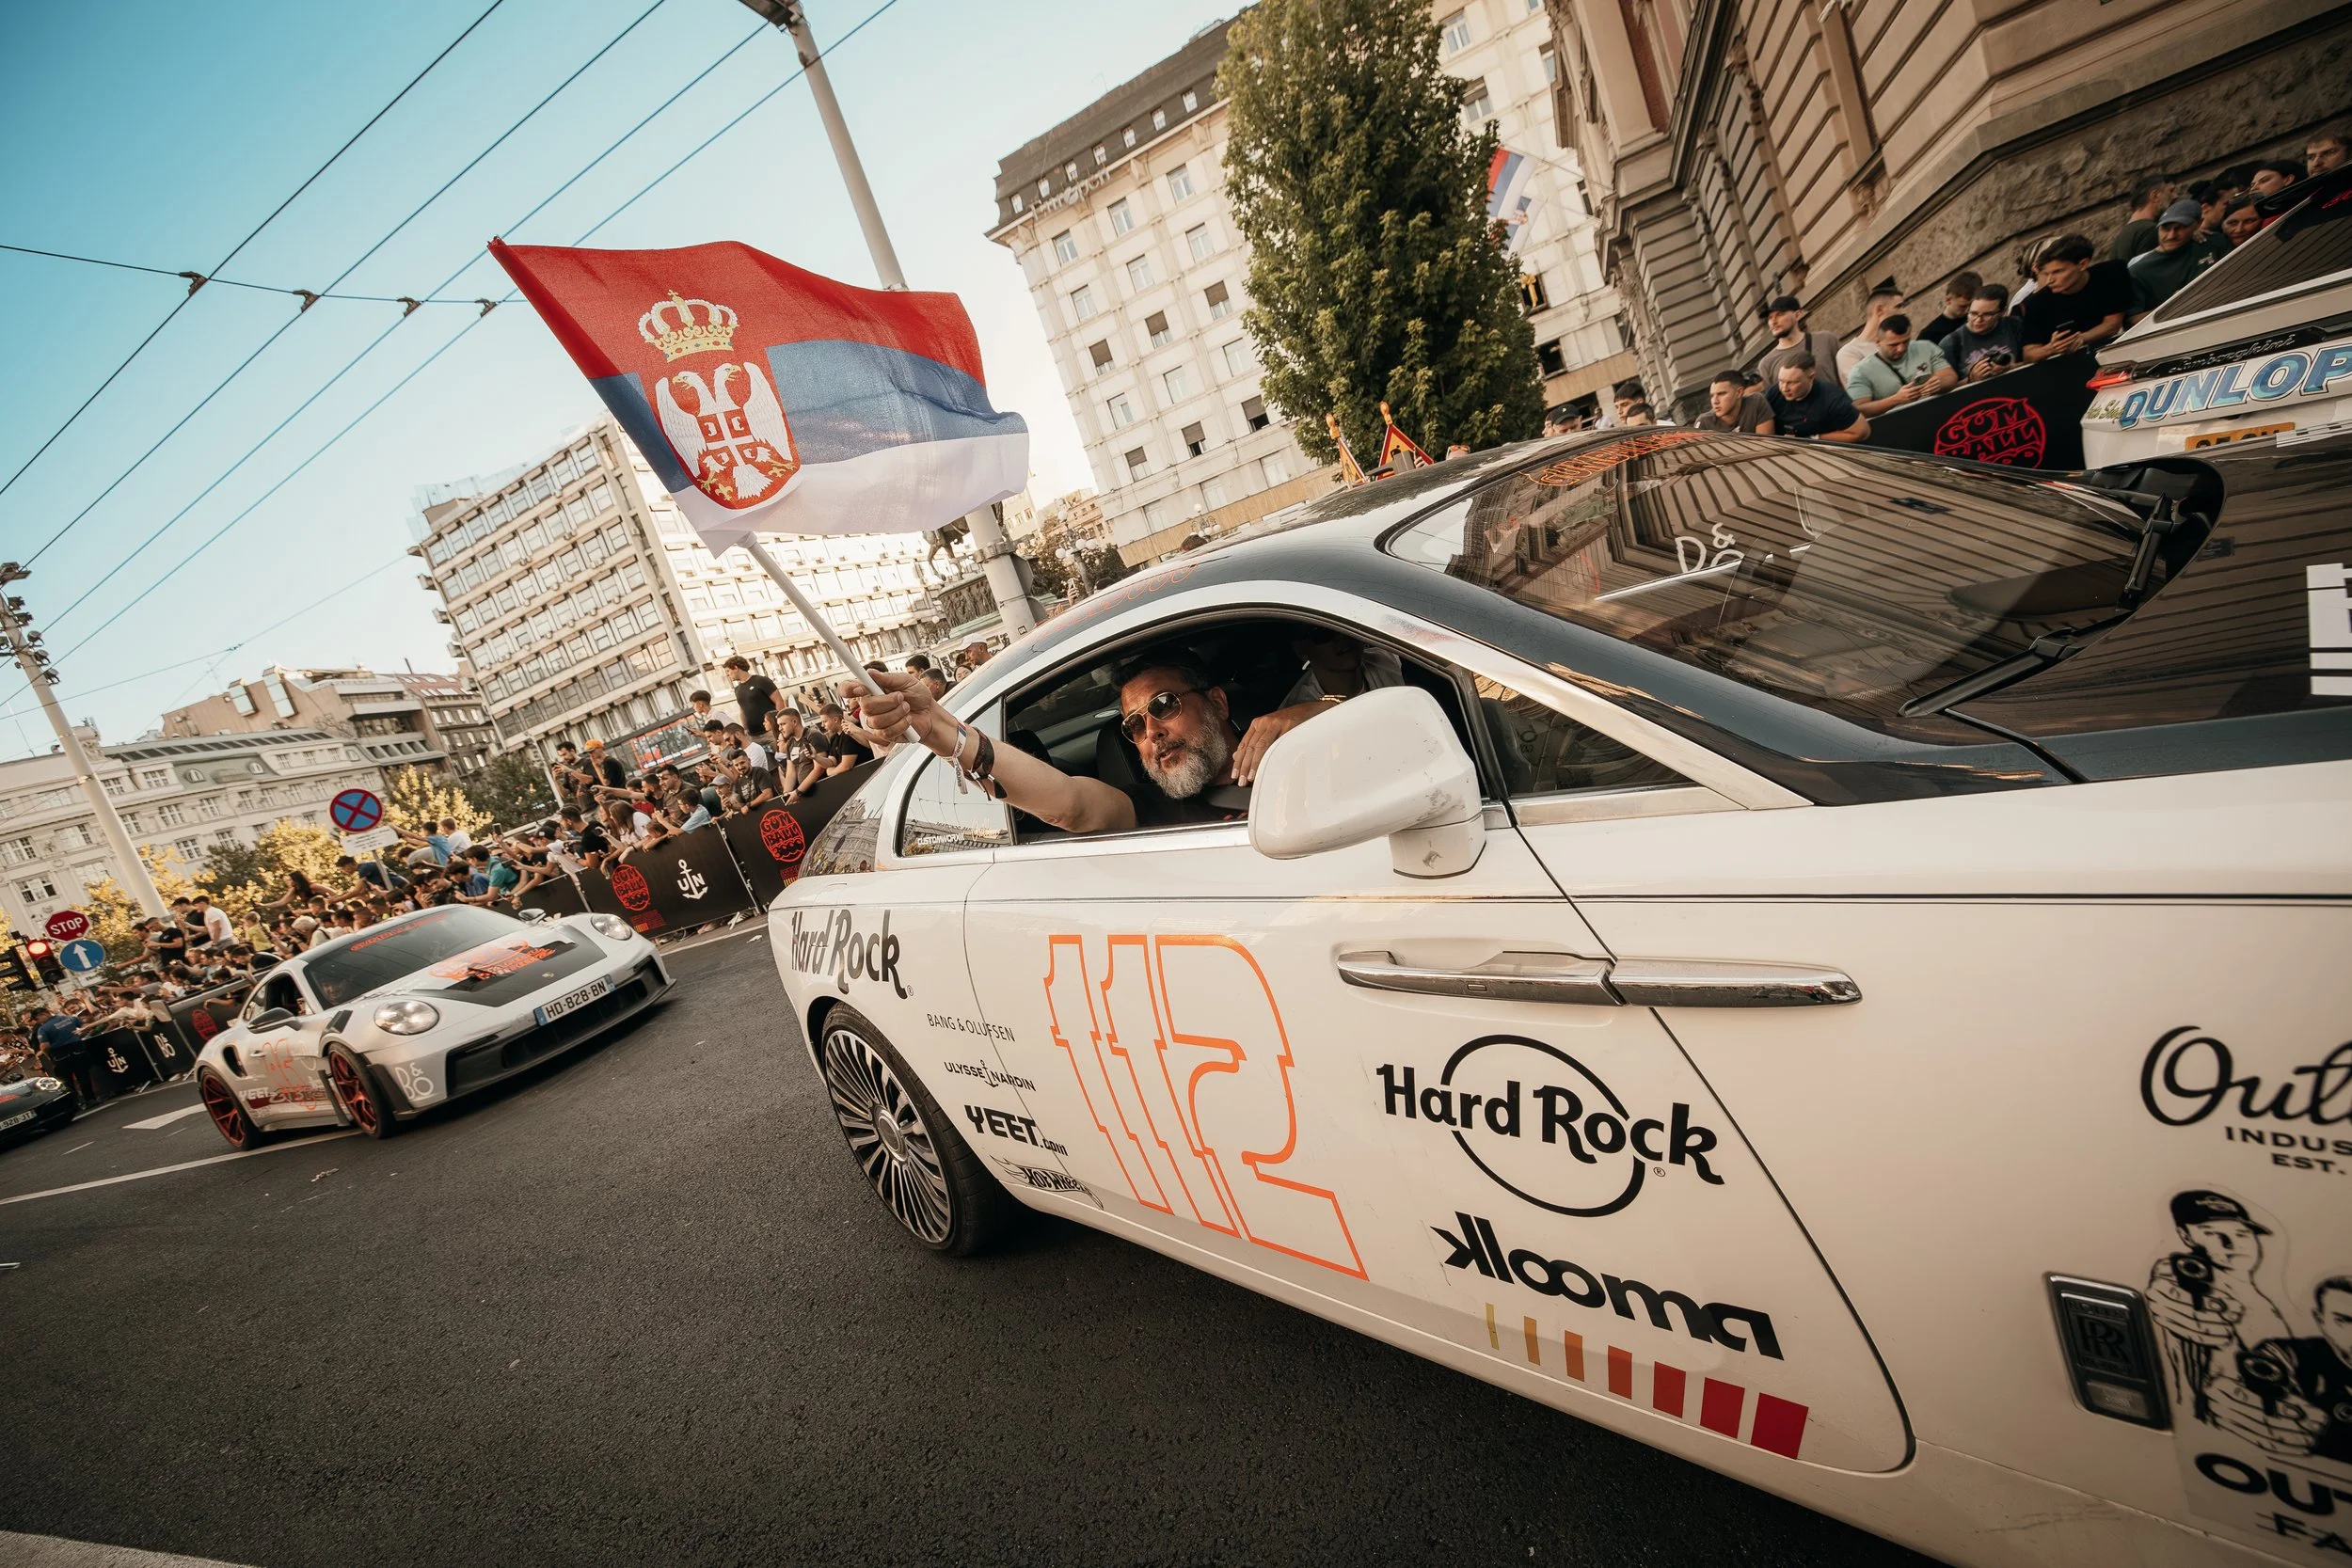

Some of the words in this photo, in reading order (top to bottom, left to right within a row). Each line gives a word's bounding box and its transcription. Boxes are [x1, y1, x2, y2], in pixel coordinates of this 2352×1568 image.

[2119, 342, 2352, 431] DUNLOP
[50, 917, 84, 935] STOP
[791, 910, 834, 974] Hard
[828, 909, 908, 1000] Rock
[546, 980, 608, 1019] HD-828-BN
[927, 1013, 956, 1032] BANG
[957, 1018, 965, 1032] &
[965, 1020, 1016, 1042] OLUFSEN
[944, 1061, 985, 1079] ULYSSE
[991, 1070, 1036, 1092] NARDIN
[1043, 934, 1370, 1281] 112
[1376, 1063, 1520, 1138] Hard
[1533, 1084, 1725, 1186] Rock
[2270, 1152, 2346, 1176] EST.
[1429, 1211, 1785, 1361] klooma
[2194, 1453, 2352, 1516] OU
